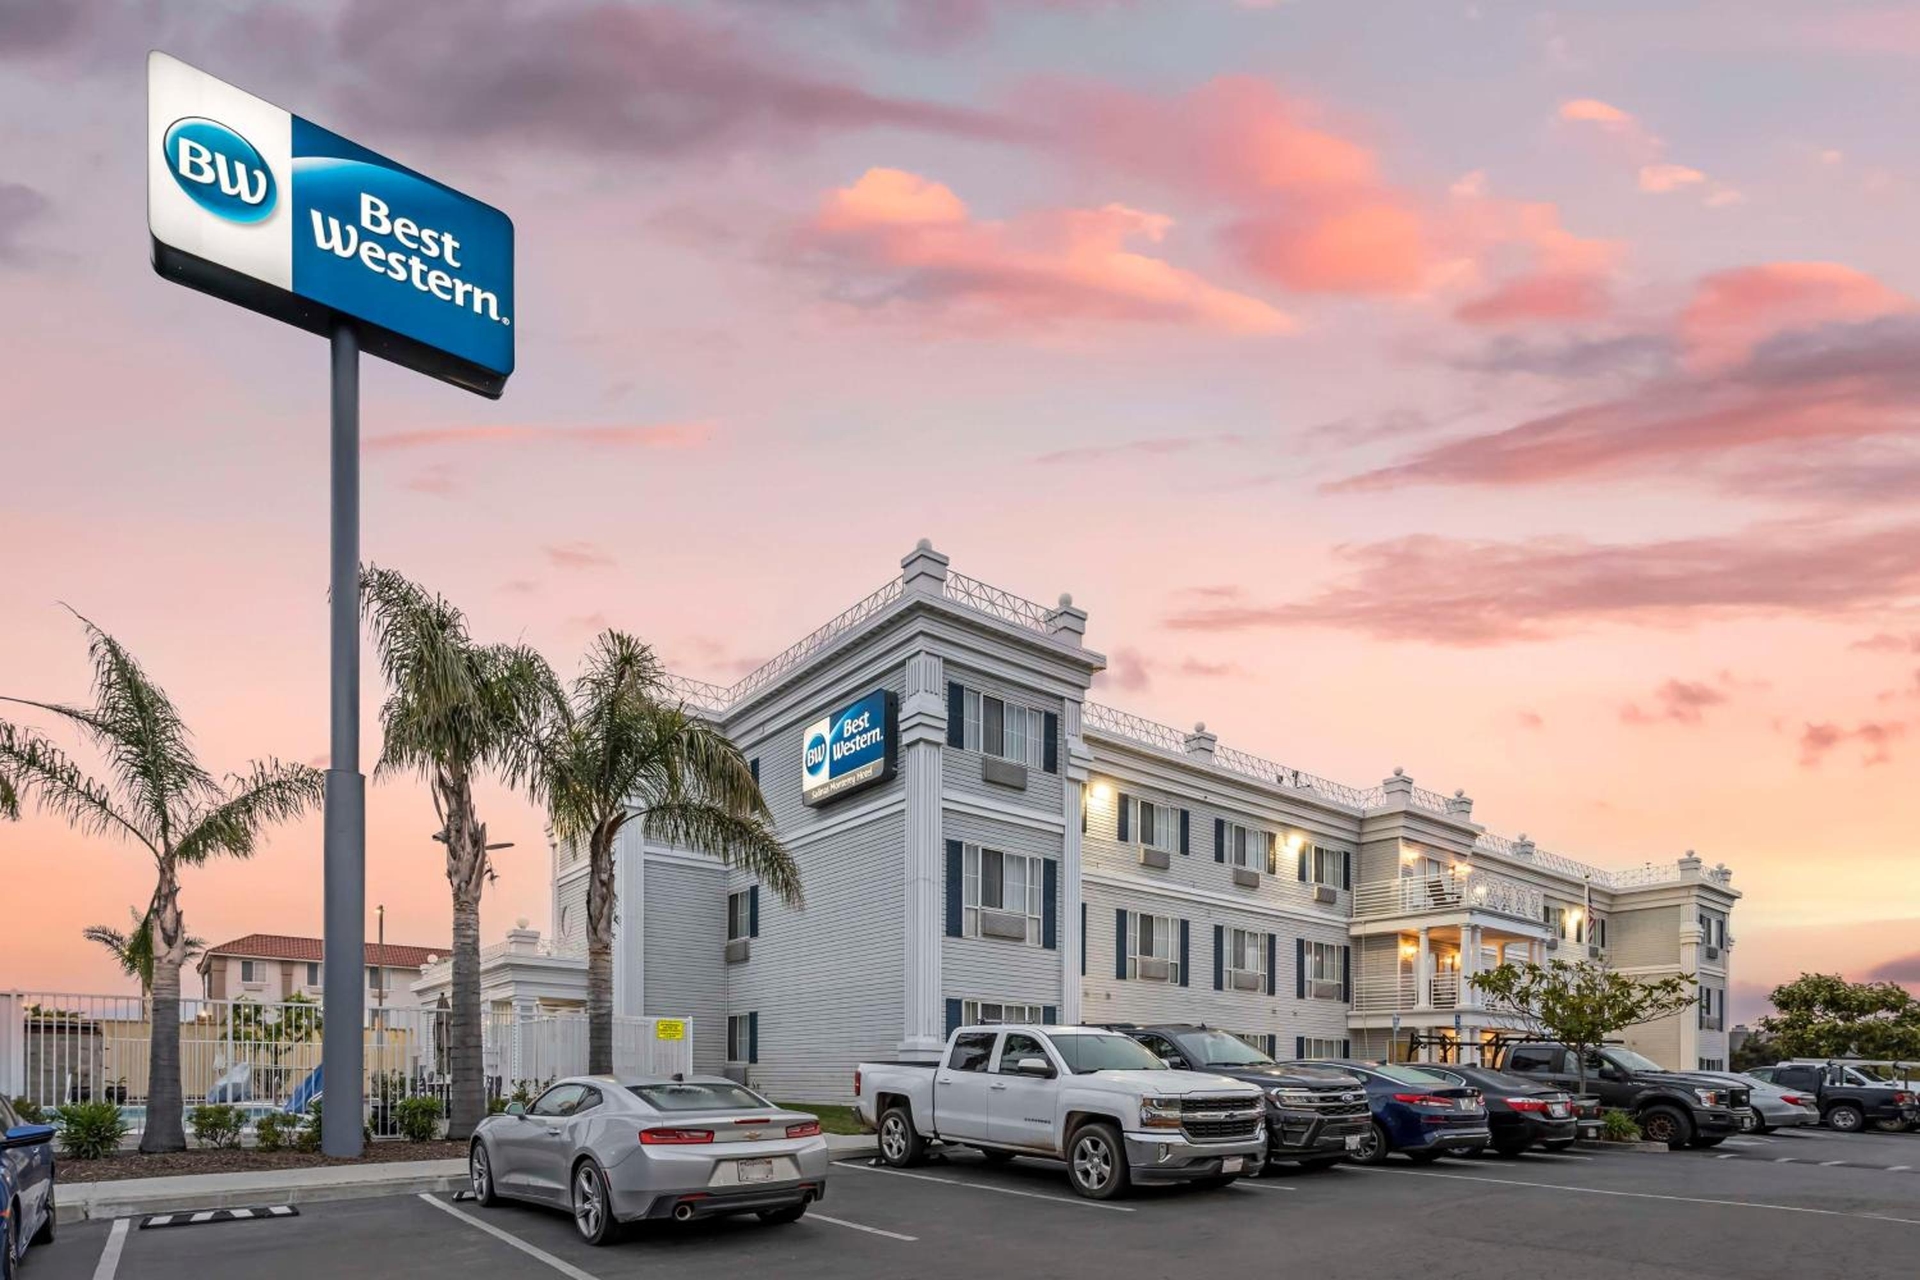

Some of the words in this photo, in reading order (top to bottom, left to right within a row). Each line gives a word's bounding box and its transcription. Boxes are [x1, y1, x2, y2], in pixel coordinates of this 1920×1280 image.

[178, 136, 268, 205] BW
[360, 192, 461, 268] Best
[843, 711, 870, 738] Best
[806, 743, 826, 768] BW
